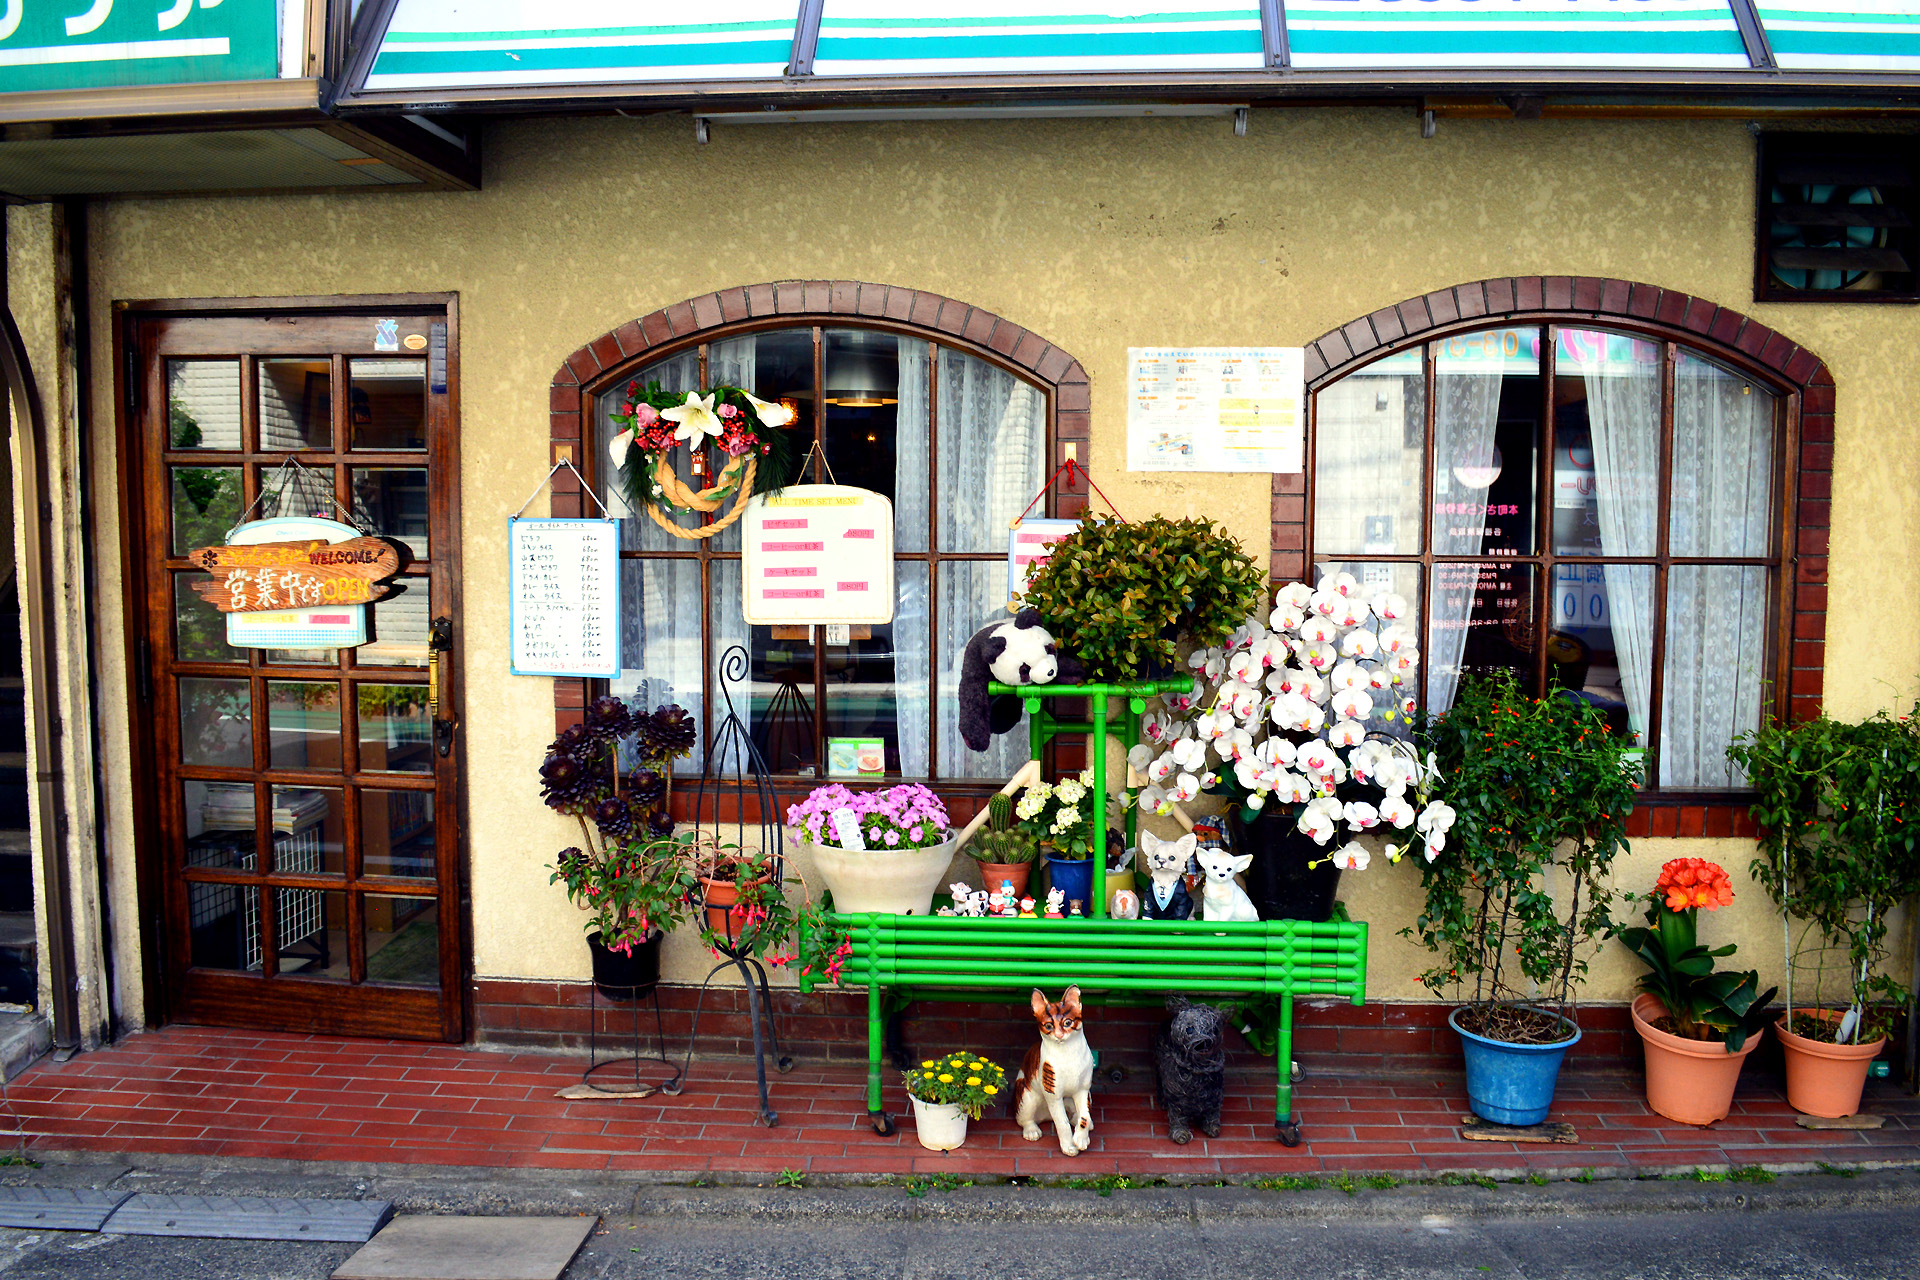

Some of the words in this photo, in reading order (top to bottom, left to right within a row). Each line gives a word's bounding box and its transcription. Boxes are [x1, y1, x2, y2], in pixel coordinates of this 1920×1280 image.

[836, 497, 859, 505] MENU
[224, 568, 324, 610] 営業中です
[322, 576, 371, 600] OPEN
